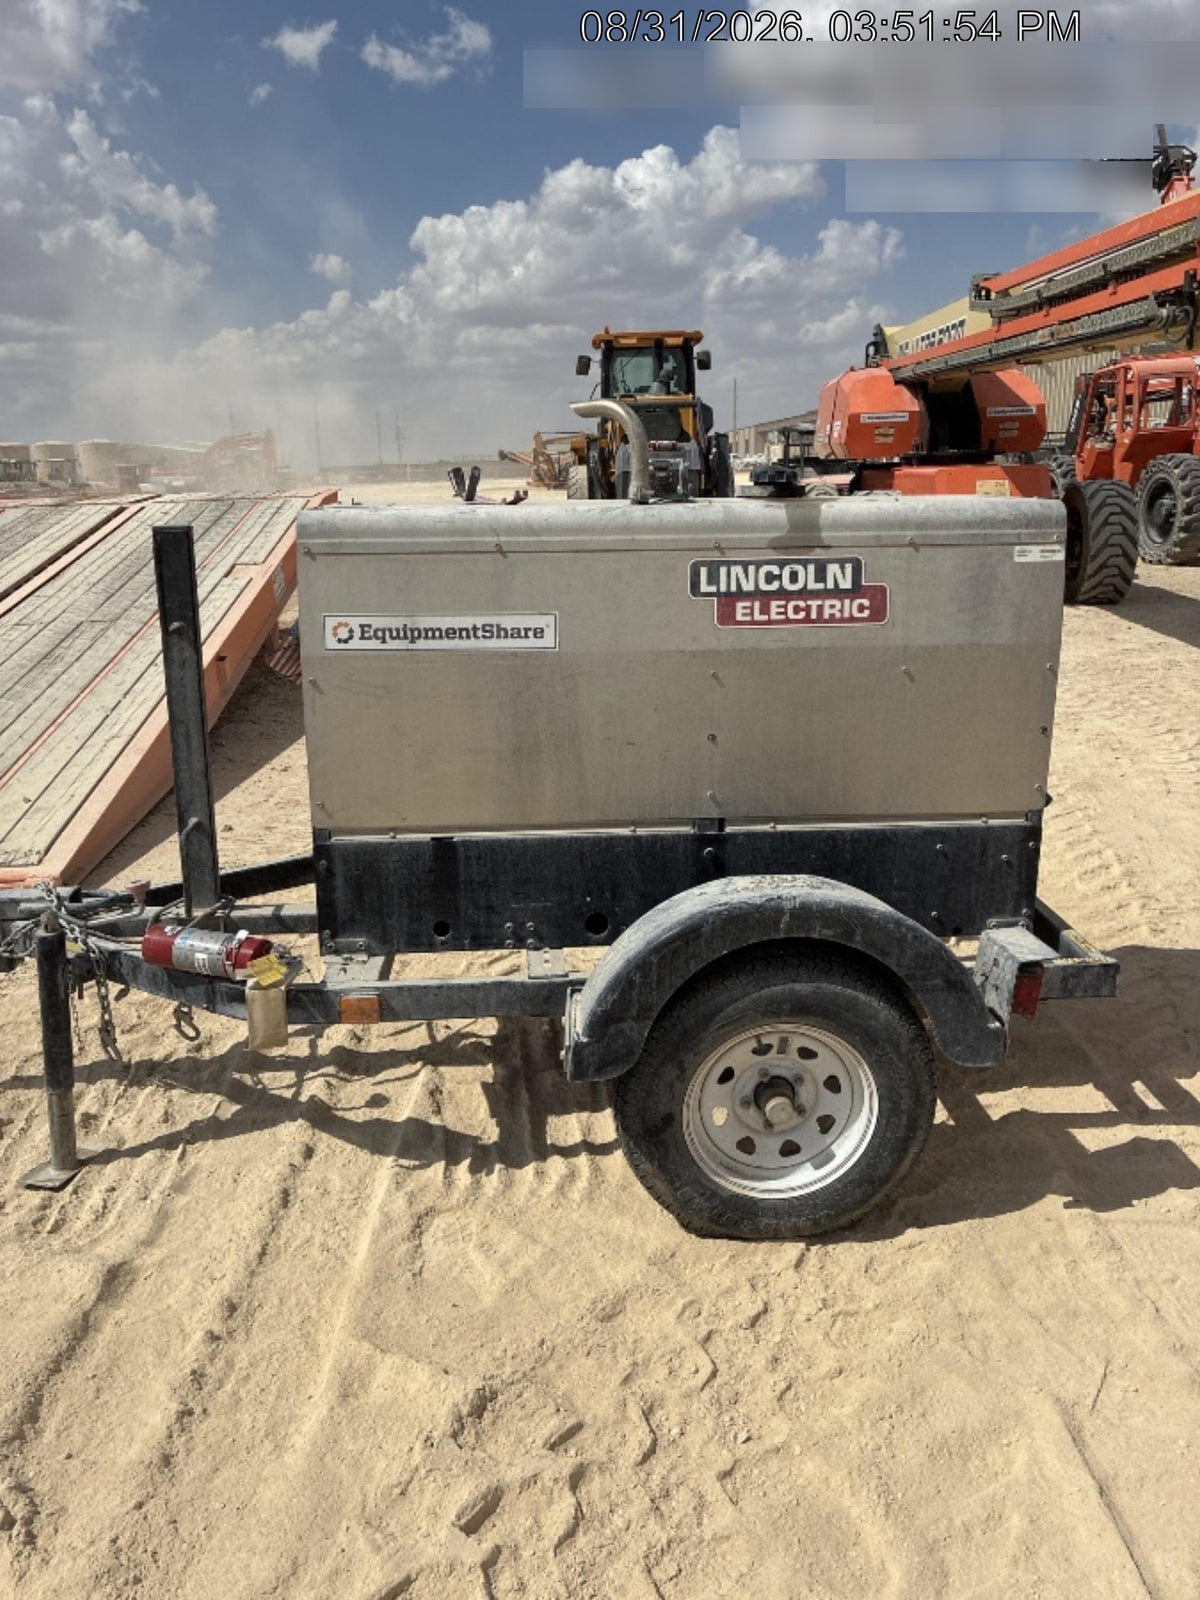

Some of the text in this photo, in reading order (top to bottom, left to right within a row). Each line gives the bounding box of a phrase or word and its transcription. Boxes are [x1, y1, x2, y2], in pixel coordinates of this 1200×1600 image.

[699, 563, 853, 593] LINCOLN
[735, 598, 871, 622] ELECTRIC
[358, 623, 545, 644] EquipmentShare
